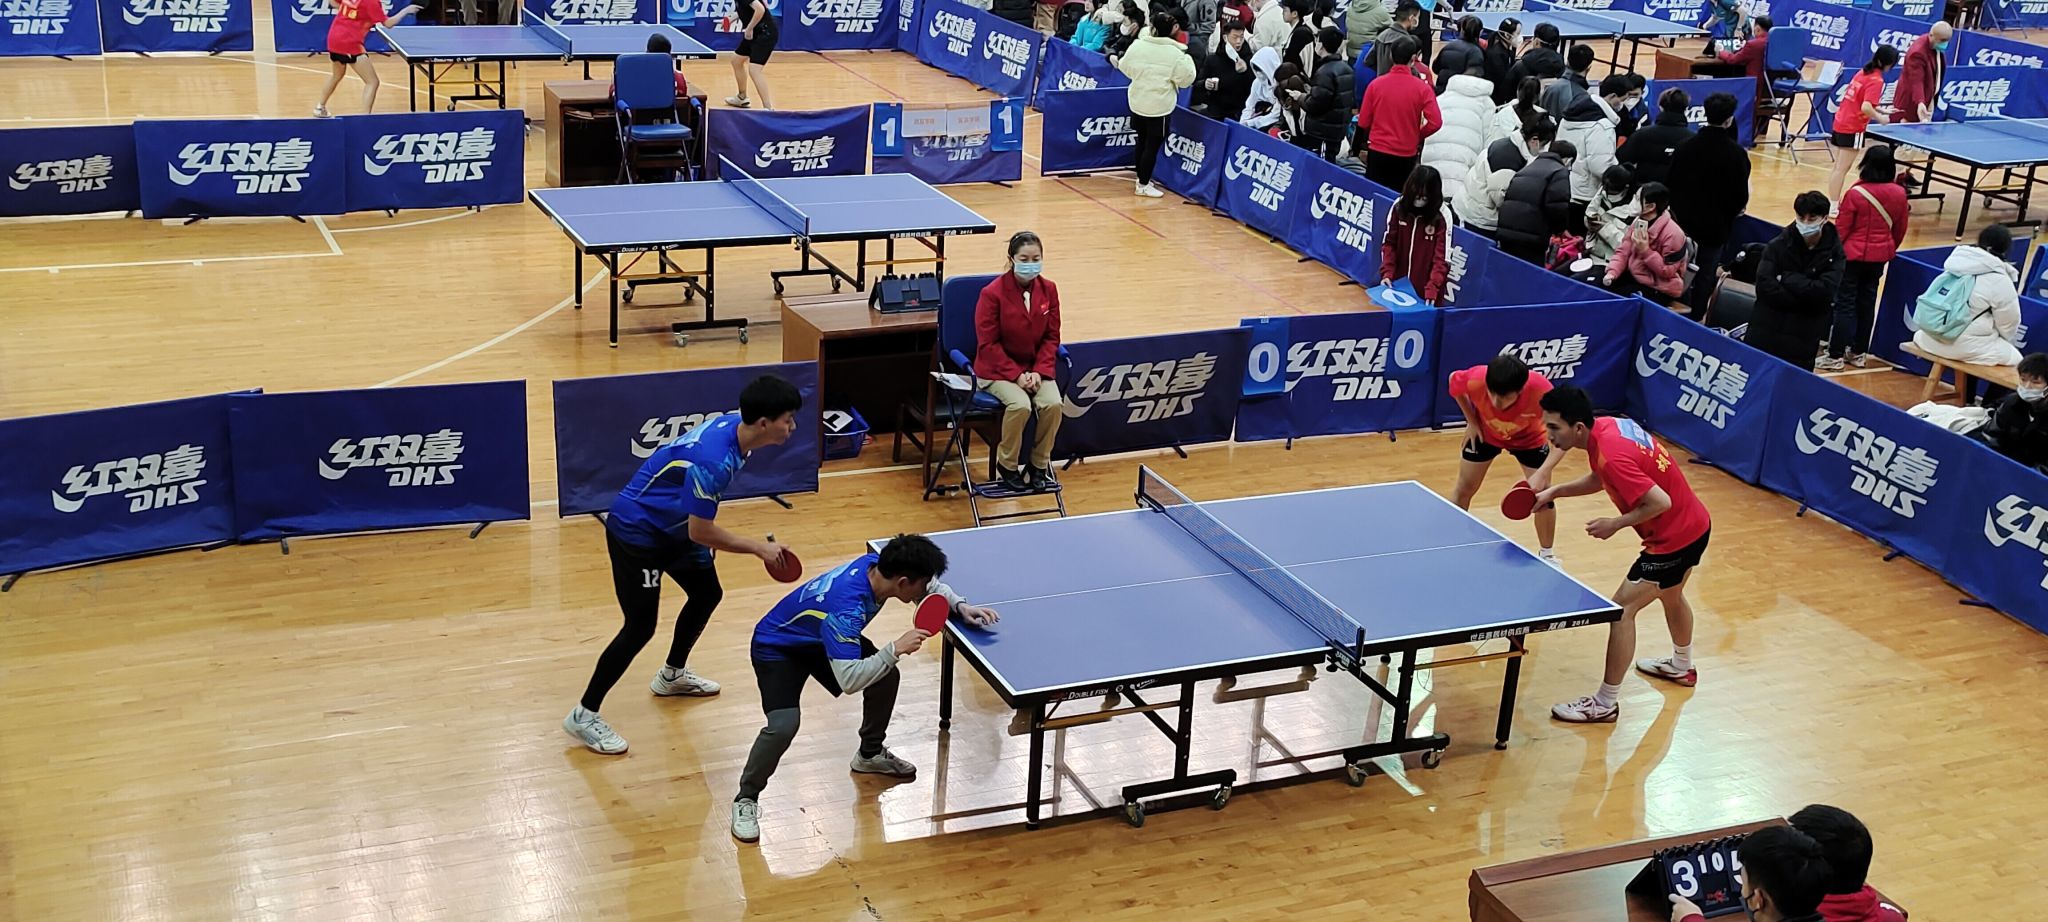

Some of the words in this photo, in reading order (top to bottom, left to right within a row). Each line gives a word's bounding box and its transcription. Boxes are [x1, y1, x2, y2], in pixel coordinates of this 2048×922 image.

[0, 0, 72, 17] 双喜
[123, 0, 231, 26] 红双喜
[800, 0, 883, 26] 红双喜
[1789, 9, 1850, 37] 红双喜
[9, 18, 70, 35] DHS
[170, 17, 228, 33] DHS
[835, 20, 878, 33] DHS
[929, 10, 977, 42] 红双喜
[947, 37, 972, 57] DHS
[984, 31, 1031, 65] 红双喜
[1811, 32, 1846, 50] DHS
[1002, 58, 1026, 80] DHS
[1937, 78, 2011, 111] 红双喜
[880, 117, 896, 147] 1
[998, 105, 1013, 134] 1
[364, 127, 497, 177] 红双喜
[755, 136, 836, 168] 红双喜
[1105, 133, 1139, 147] DHS
[1165, 132, 1206, 162] 红双喜
[9, 154, 114, 191] 红双喜
[168, 137, 315, 187] 红双喜
[421, 161, 492, 184] DHS
[790, 155, 834, 172] DHS
[1181, 157, 1202, 176] DHS
[1224, 145, 1295, 193] 红双喜
[57, 176, 113, 194] DHS
[232, 172, 310, 195] DHS
[1249, 181, 1285, 212] DHS
[1310, 182, 1374, 233] 红双喜
[1336, 221, 1372, 253] DHS
[1382, 288, 1418, 307] 0
[1248, 342, 1280, 383] 0
[1394, 329, 1425, 369] 0
[1062, 351, 1218, 418] 红双喜
[1635, 333, 1750, 406] 红双喜
[1126, 392, 1205, 424] DHS
[1676, 384, 1736, 430] DHS
[318, 428, 465, 480] 红双喜
[1795, 407, 1940, 494] 红双喜
[51, 443, 207, 513] 红双喜
[384, 464, 464, 487] DHS
[124, 479, 207, 513] DHS
[1850, 464, 1928, 519] DHS
[642, 568, 660, 588] 12
[1068, 690, 1094, 700] DOUBLE
[1672, 860, 1698, 897] 3
